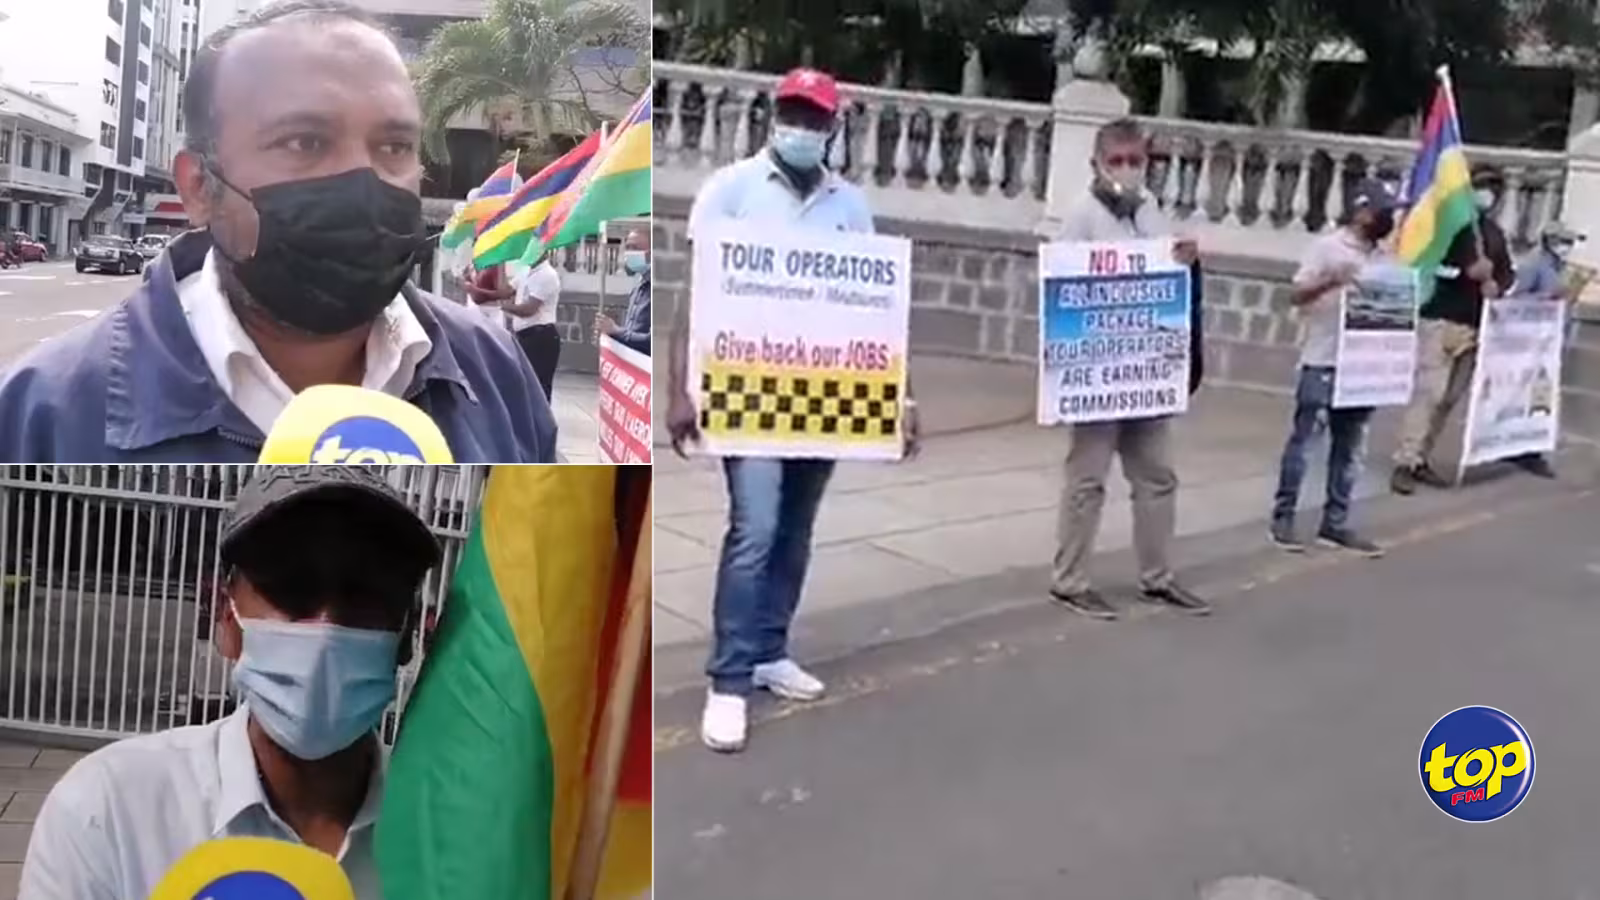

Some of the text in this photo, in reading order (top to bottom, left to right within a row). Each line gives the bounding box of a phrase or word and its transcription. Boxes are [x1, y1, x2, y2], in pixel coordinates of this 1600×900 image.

[720, 243, 896, 286] TOUR OPERATORS
[1089, 249, 1147, 274] NO TO
[1092, 280, 1176, 303] INCLUSIVE
[1085, 309, 1157, 332] PACKAGE
[714, 331, 890, 371] Give back our JOBS
[1093, 334, 1185, 358] OPERATORS
[1060, 362, 1172, 388] ARE EARNING
[1058, 387, 1178, 415] COMMISSIONS
